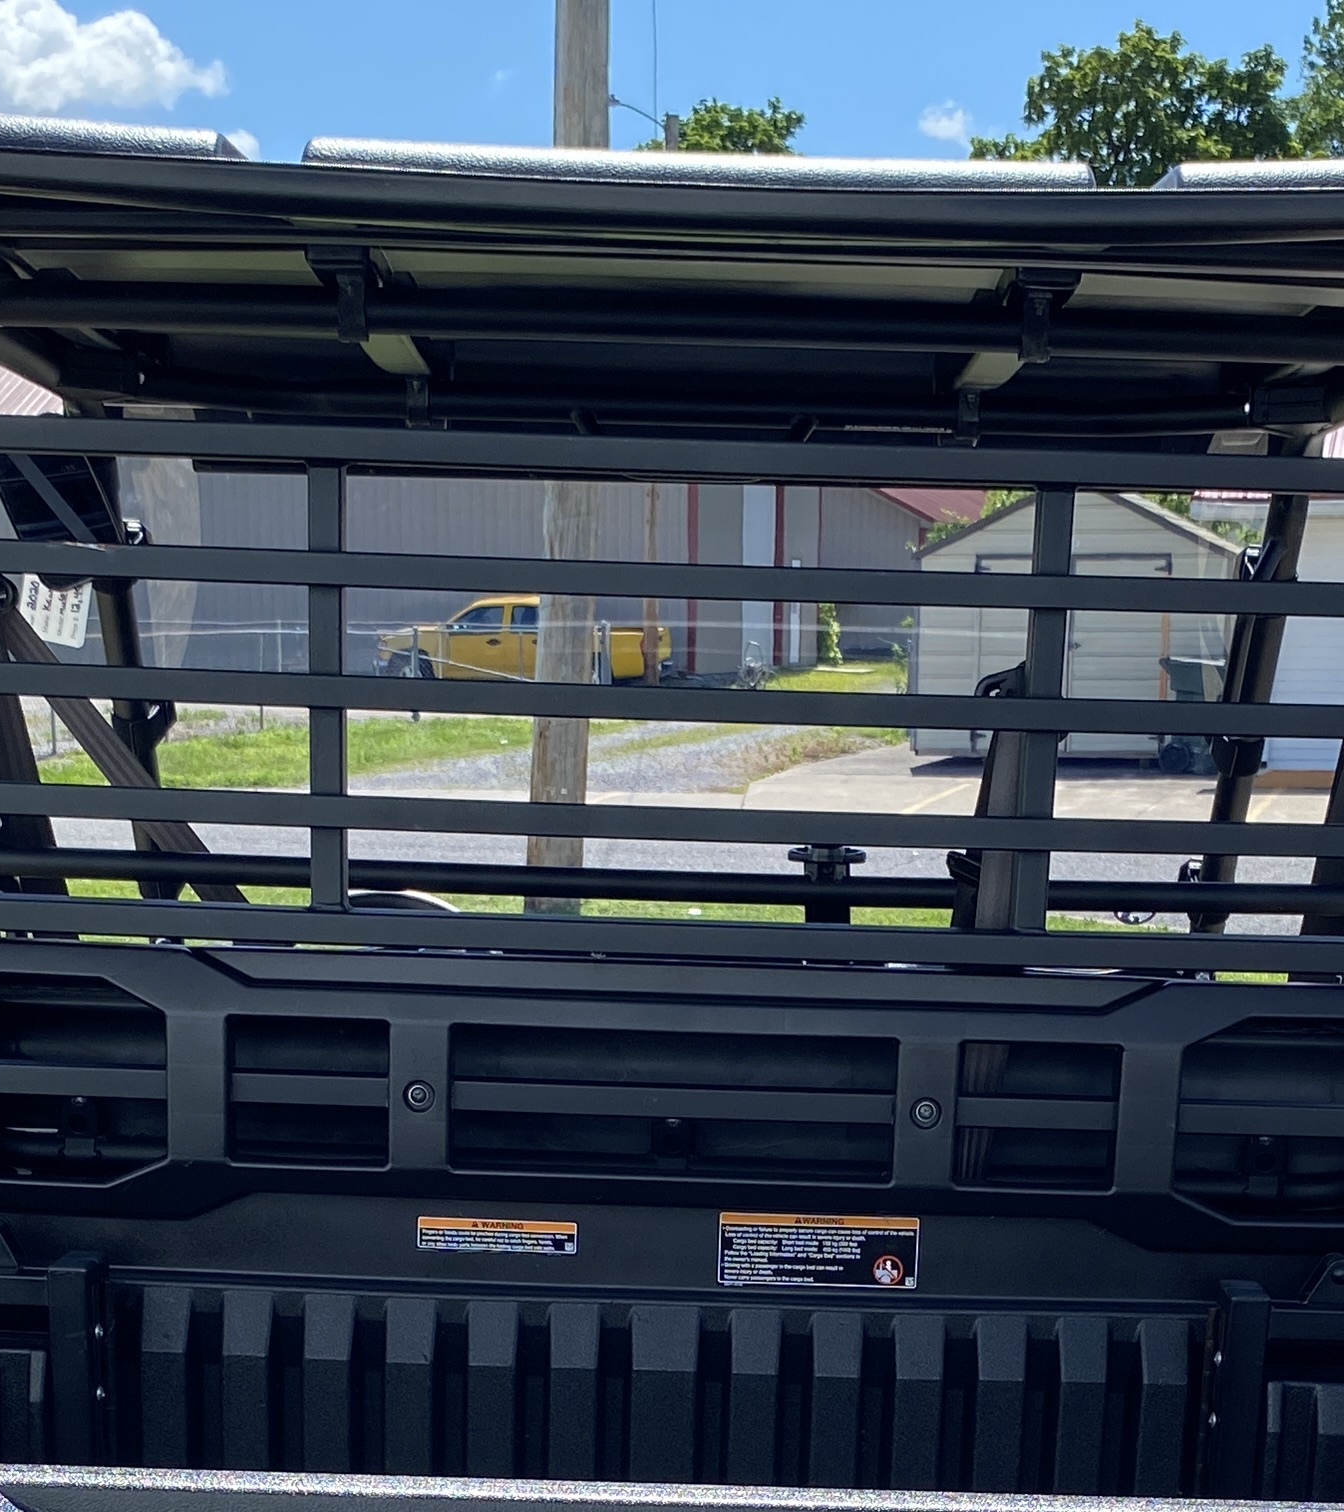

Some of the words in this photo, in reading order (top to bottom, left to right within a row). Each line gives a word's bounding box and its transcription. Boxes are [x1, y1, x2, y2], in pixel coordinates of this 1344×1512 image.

[26, 581, 40, 611] 2020
[481, 1221, 524, 1230] WARNING
[802, 1217, 845, 1225] WARNING
